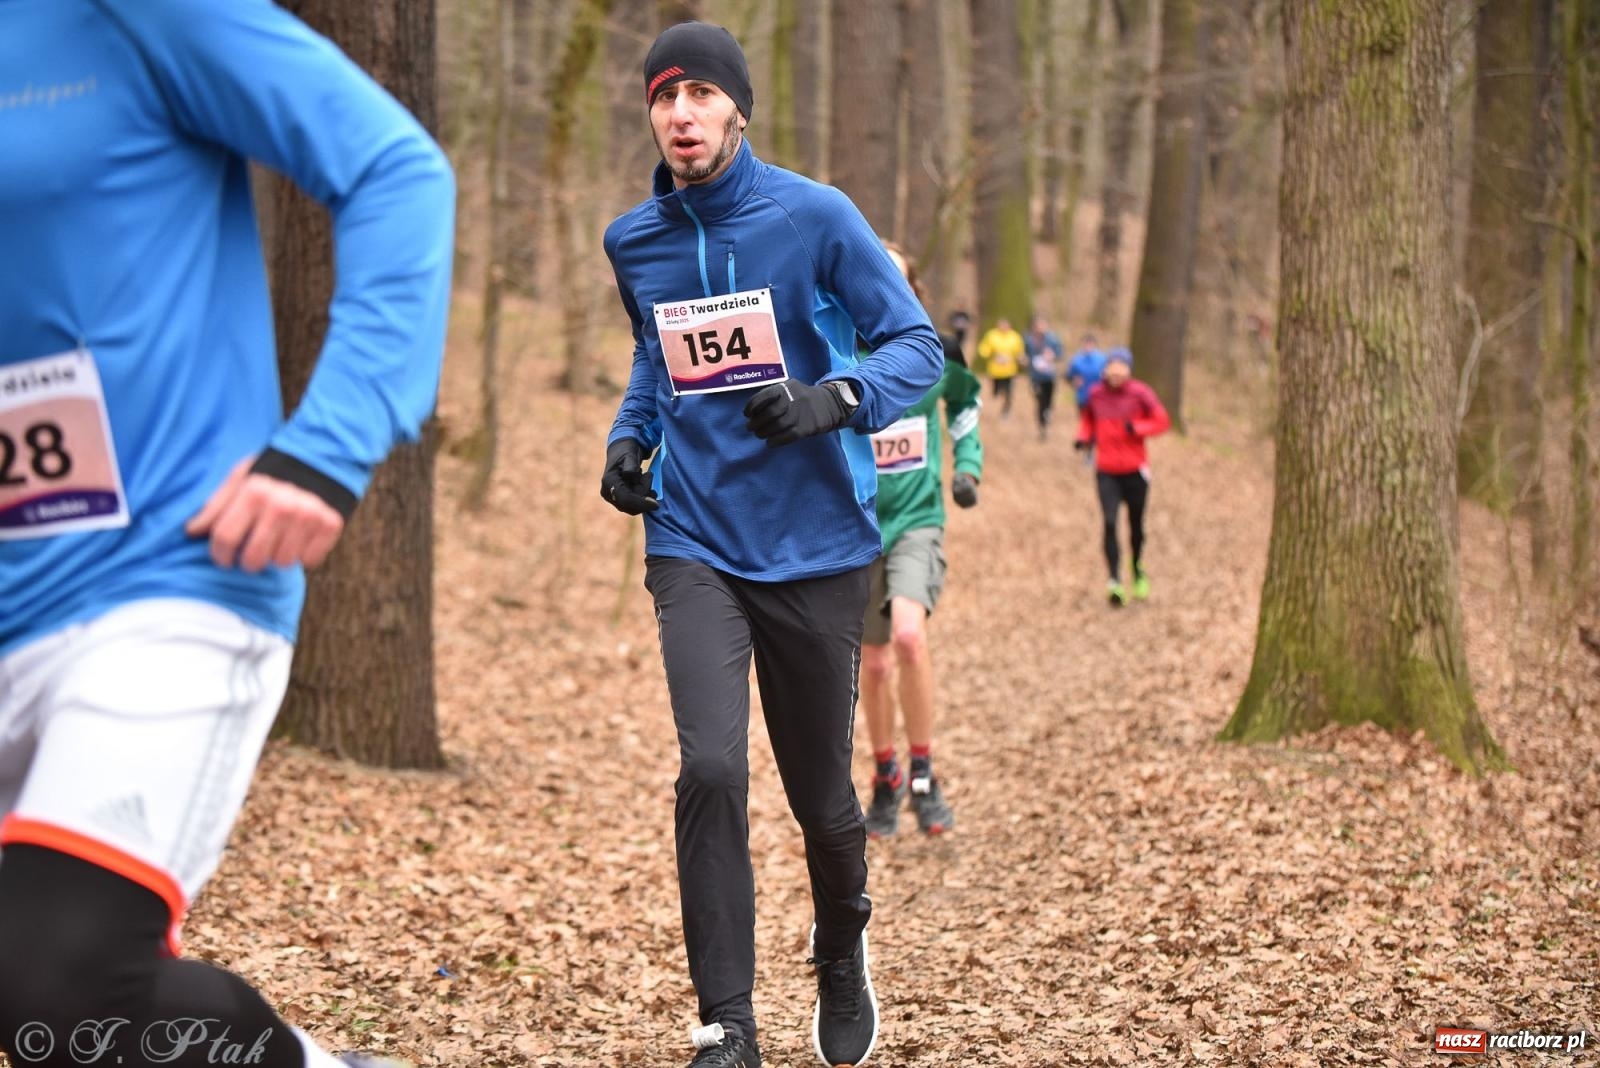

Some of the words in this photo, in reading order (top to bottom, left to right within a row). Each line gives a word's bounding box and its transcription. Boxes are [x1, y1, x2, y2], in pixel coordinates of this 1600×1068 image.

[663, 306, 688, 318] BIEG
[689, 295, 760, 315] Twardziela
[682, 326, 752, 367] 154
[875, 437, 910, 458] 170
